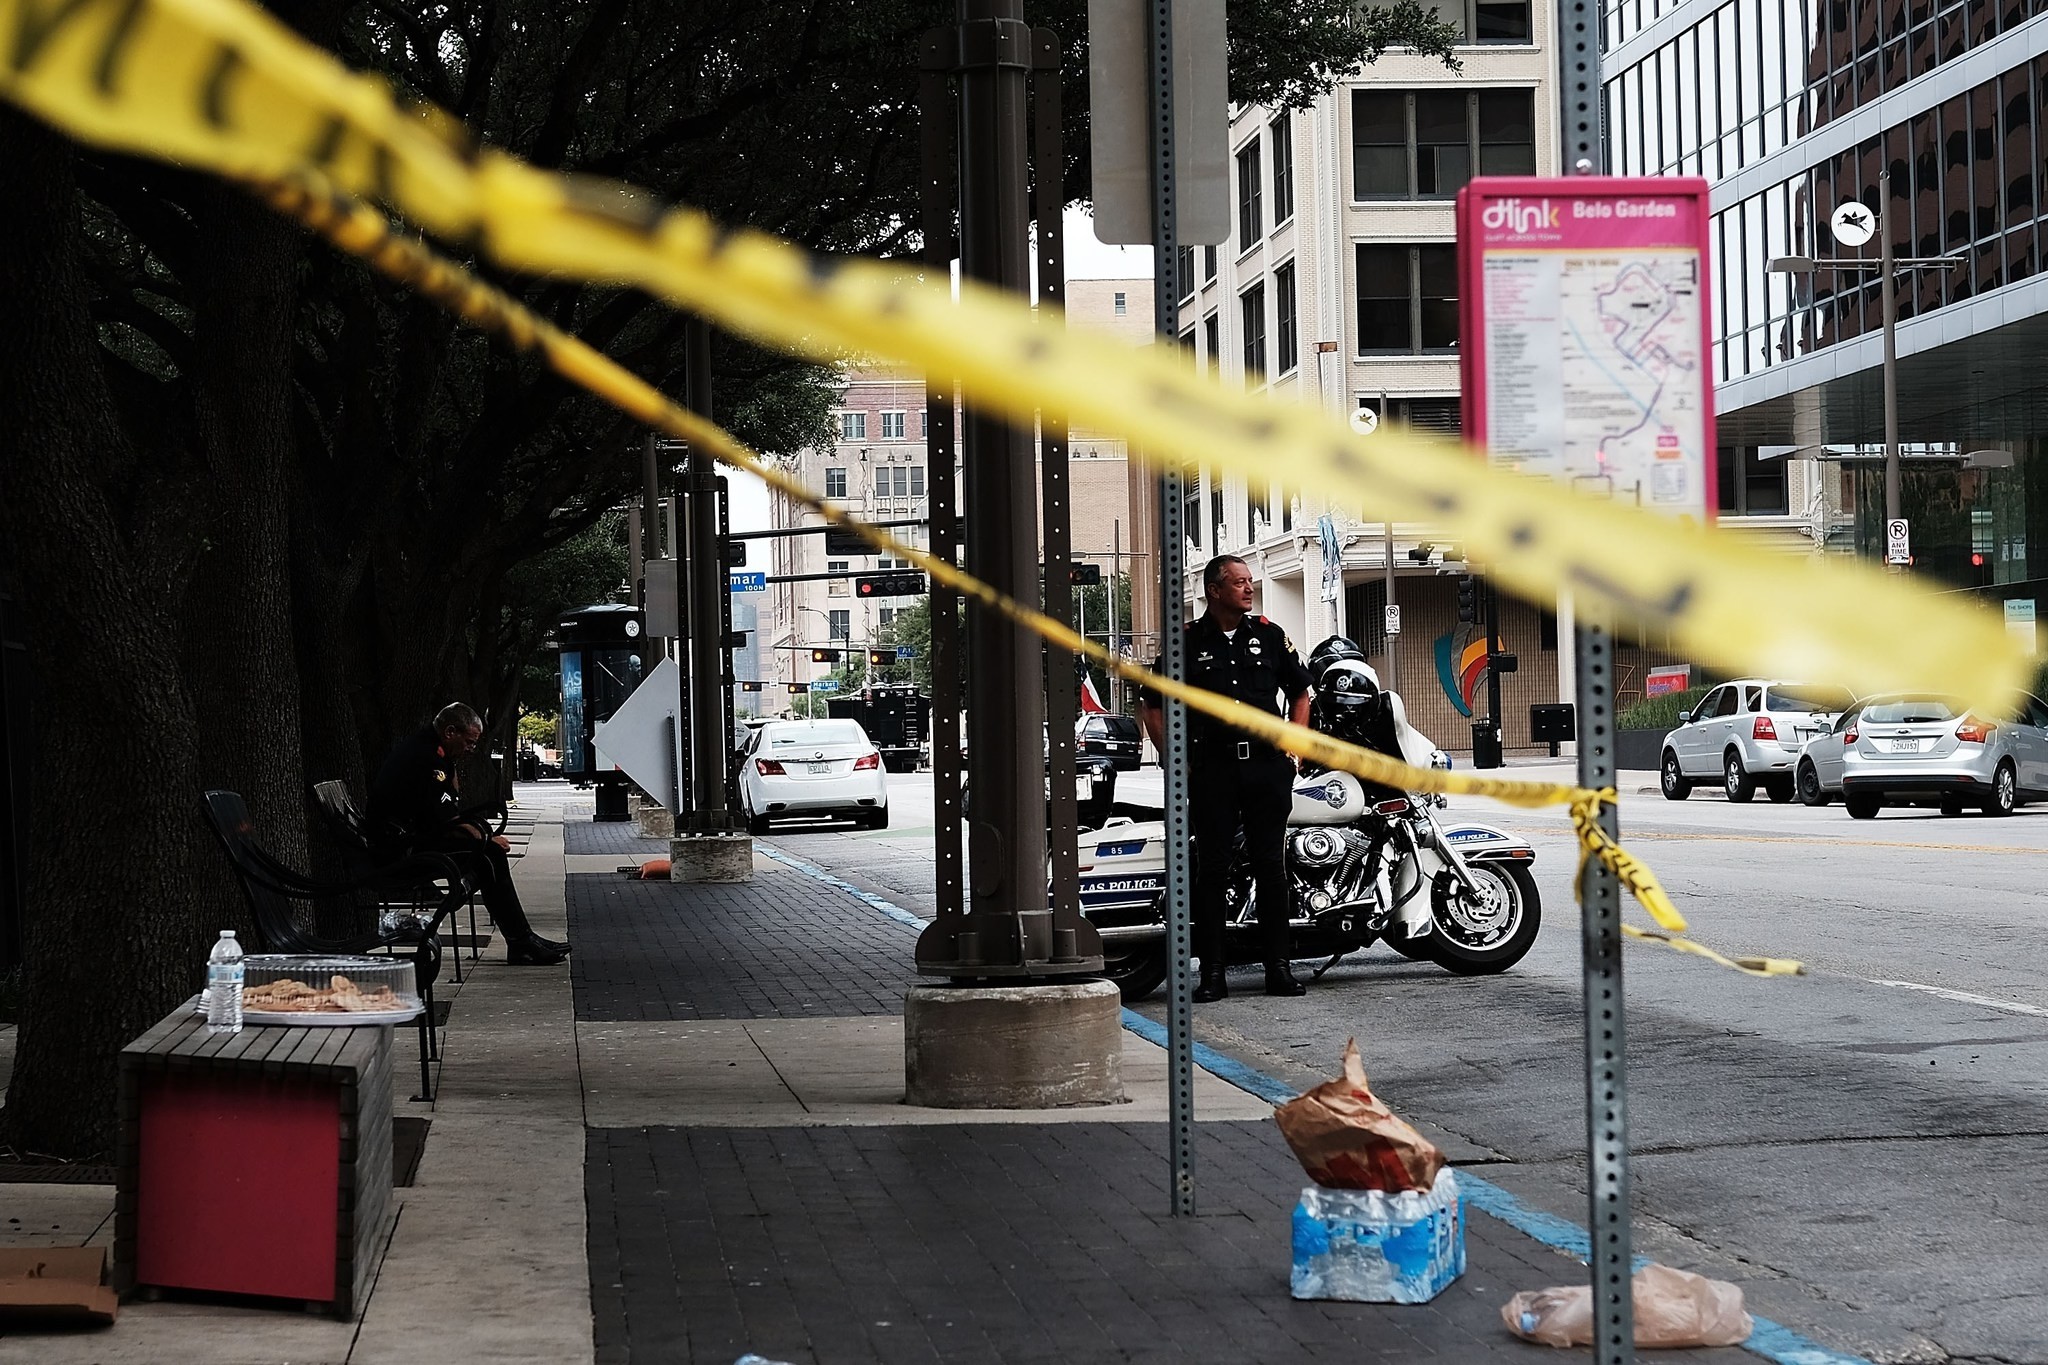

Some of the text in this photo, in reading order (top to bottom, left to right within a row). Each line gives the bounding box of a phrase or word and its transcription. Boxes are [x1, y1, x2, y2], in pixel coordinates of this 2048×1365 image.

[1573, 200, 1676, 218] Belo Garden
[730, 575, 757, 585] mar
[1109, 879, 1157, 890] POLICE
